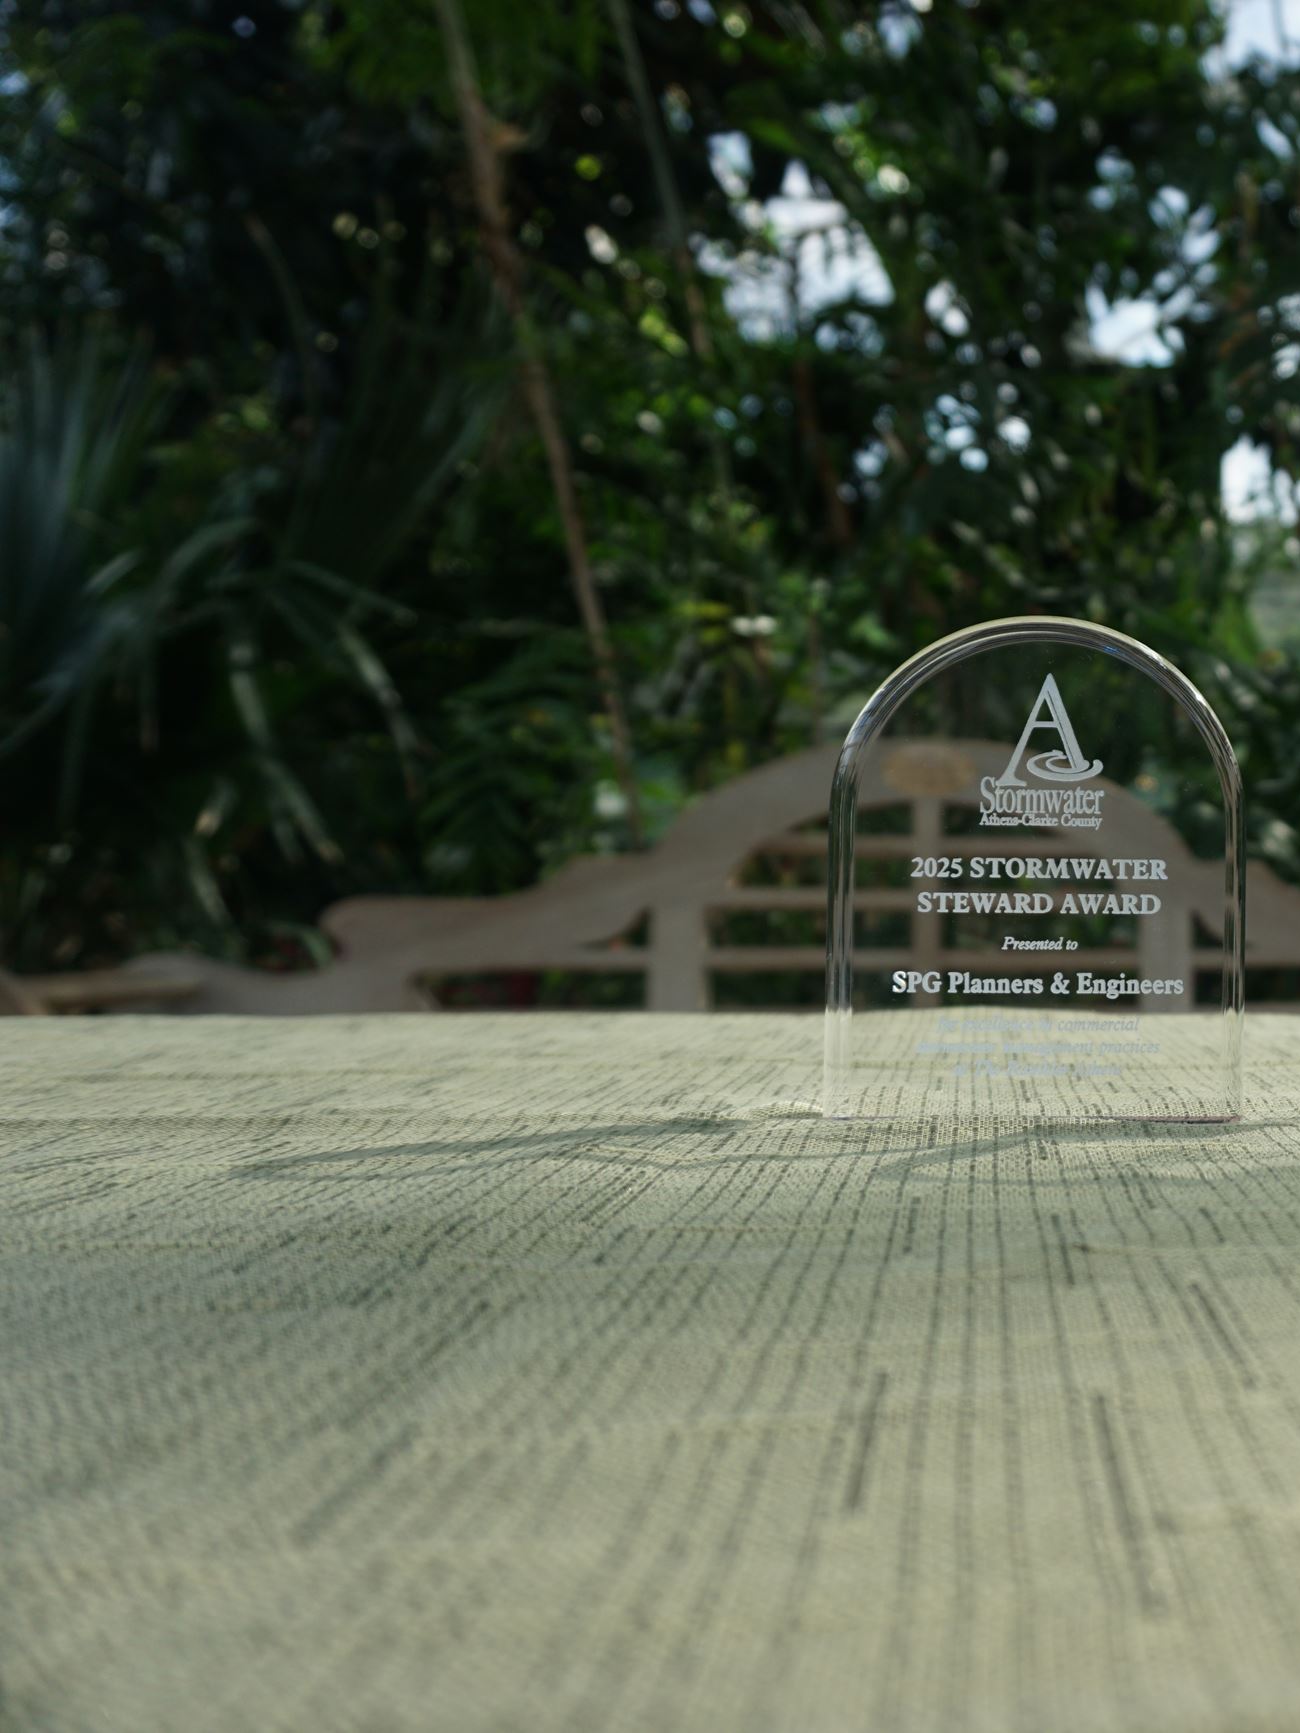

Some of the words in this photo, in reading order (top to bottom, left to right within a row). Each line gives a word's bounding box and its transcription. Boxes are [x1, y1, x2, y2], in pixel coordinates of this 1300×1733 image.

[980, 776, 1105, 815] Stormwater
[979, 812, 1059, 827] Athens-Clarke
[1060, 813, 1103, 830] County
[910, 857, 963, 878] 2025
[969, 857, 1169, 880] STORMWATER
[917, 892, 1054, 914] STEWARD
[1059, 893, 1162, 915] AWARD
[1001, 936, 1064, 951] Presented
[1065, 938, 1079, 951] to
[892, 971, 942, 994] SPG
[947, 971, 1044, 994] Planners
[1050, 972, 1070, 995] &
[1076, 972, 1184, 1000] Engineers
[1056, 1016, 1140, 1032] commercial
[1099, 1038, 1161, 1055] practices
